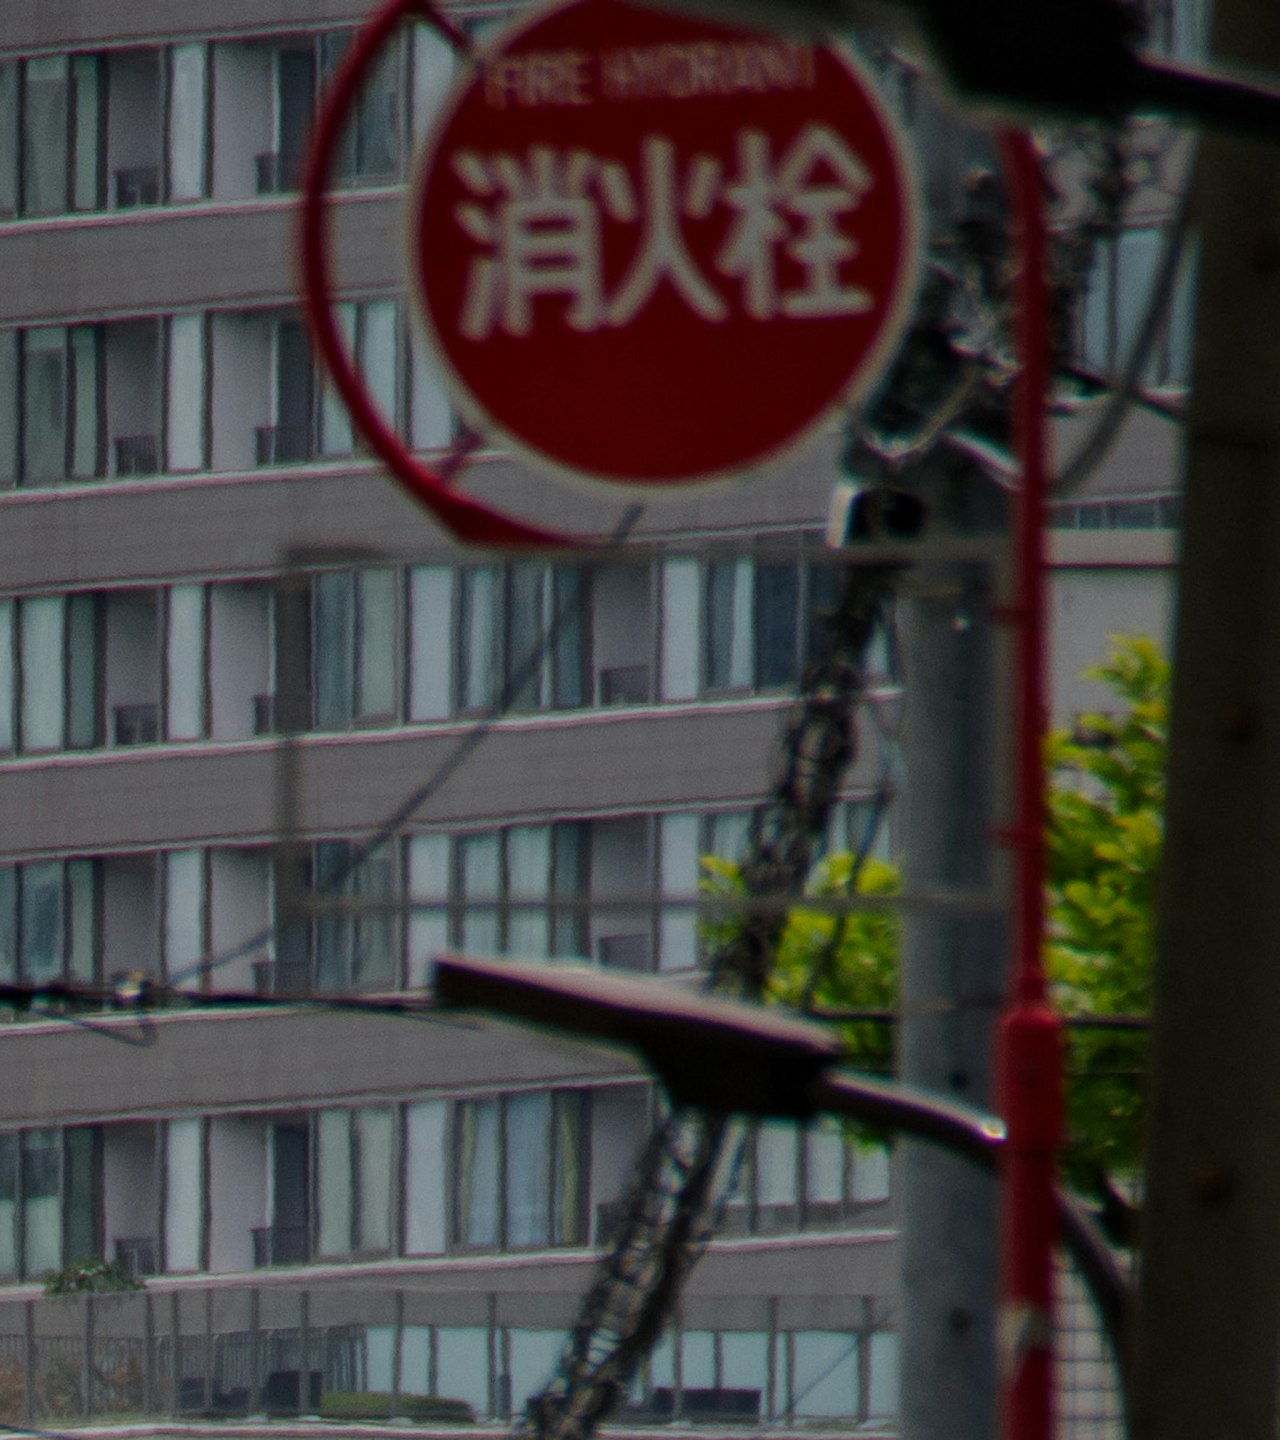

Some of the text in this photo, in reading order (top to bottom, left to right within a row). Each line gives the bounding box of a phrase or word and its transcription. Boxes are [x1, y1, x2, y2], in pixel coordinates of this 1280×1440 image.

[489, 43, 815, 108] FIRE HYDRANT
[454, 125, 872, 340] 消火栓
